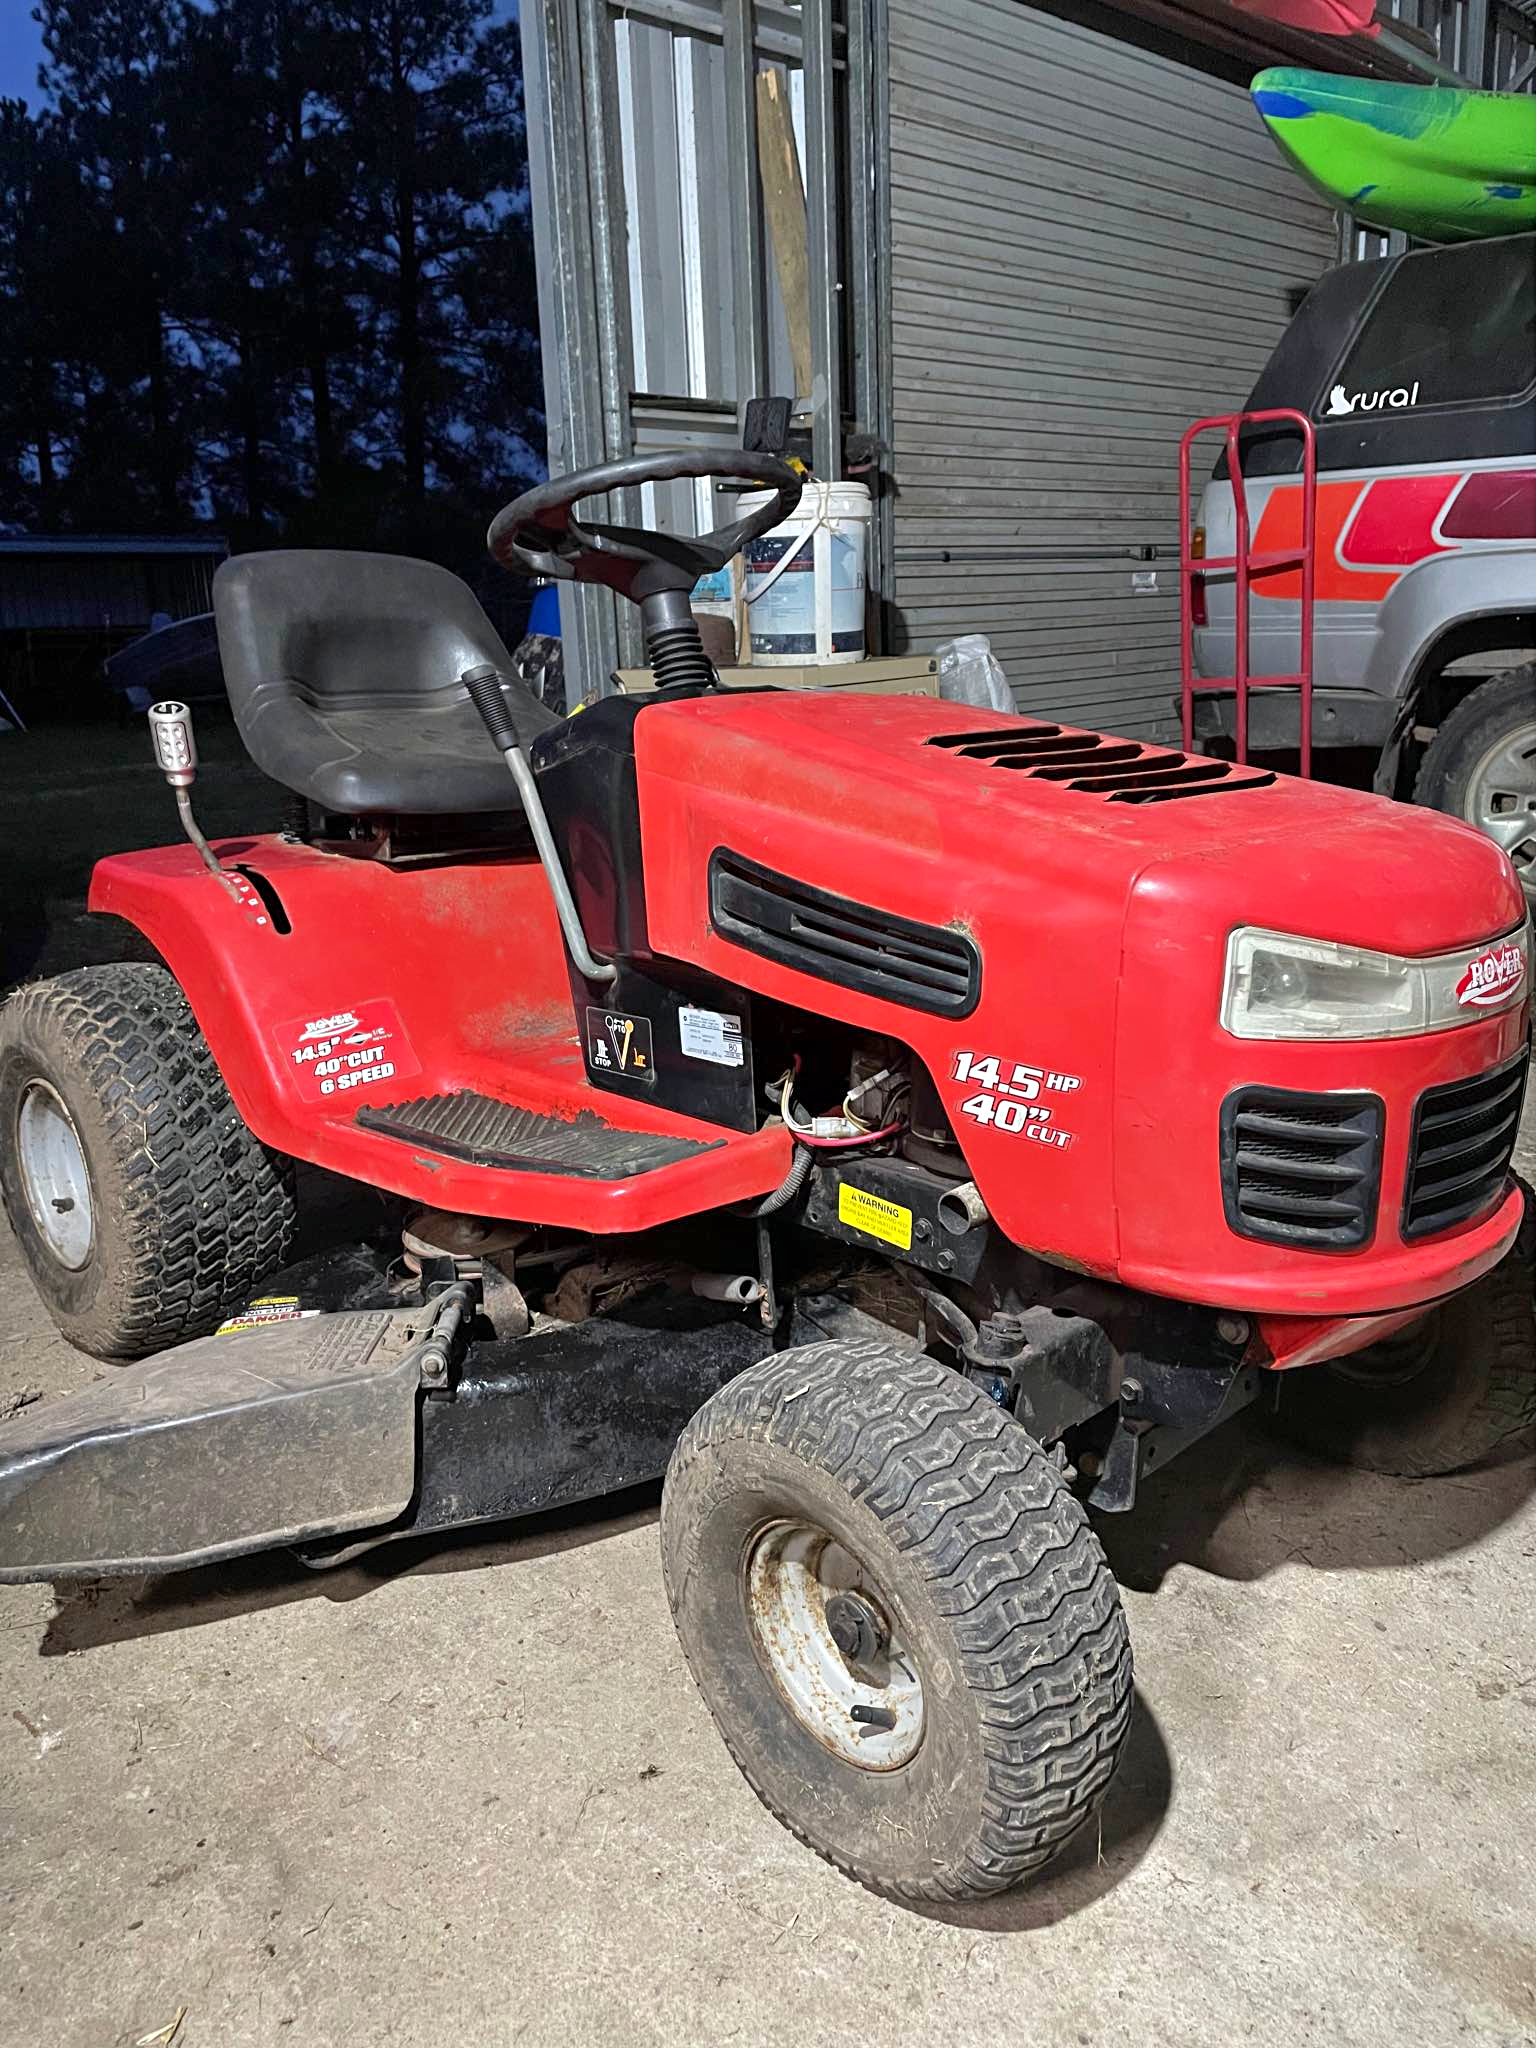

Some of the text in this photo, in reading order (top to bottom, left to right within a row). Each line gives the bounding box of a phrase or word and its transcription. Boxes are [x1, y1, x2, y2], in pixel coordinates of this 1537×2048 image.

[1350, 381, 1419, 412] rural
[1470, 946, 1523, 988] ROVER
[304, 1011, 354, 1032] ROVER
[594, 1057, 612, 1067] STOP
[320, 1062, 395, 1094] 6 SPEED
[954, 1051, 1081, 1101] 14.5 HP
[1026, 1124, 1072, 1148] CUT
[858, 1194, 899, 1219] WARNING
[232, 1312, 302, 1325] DANGER
